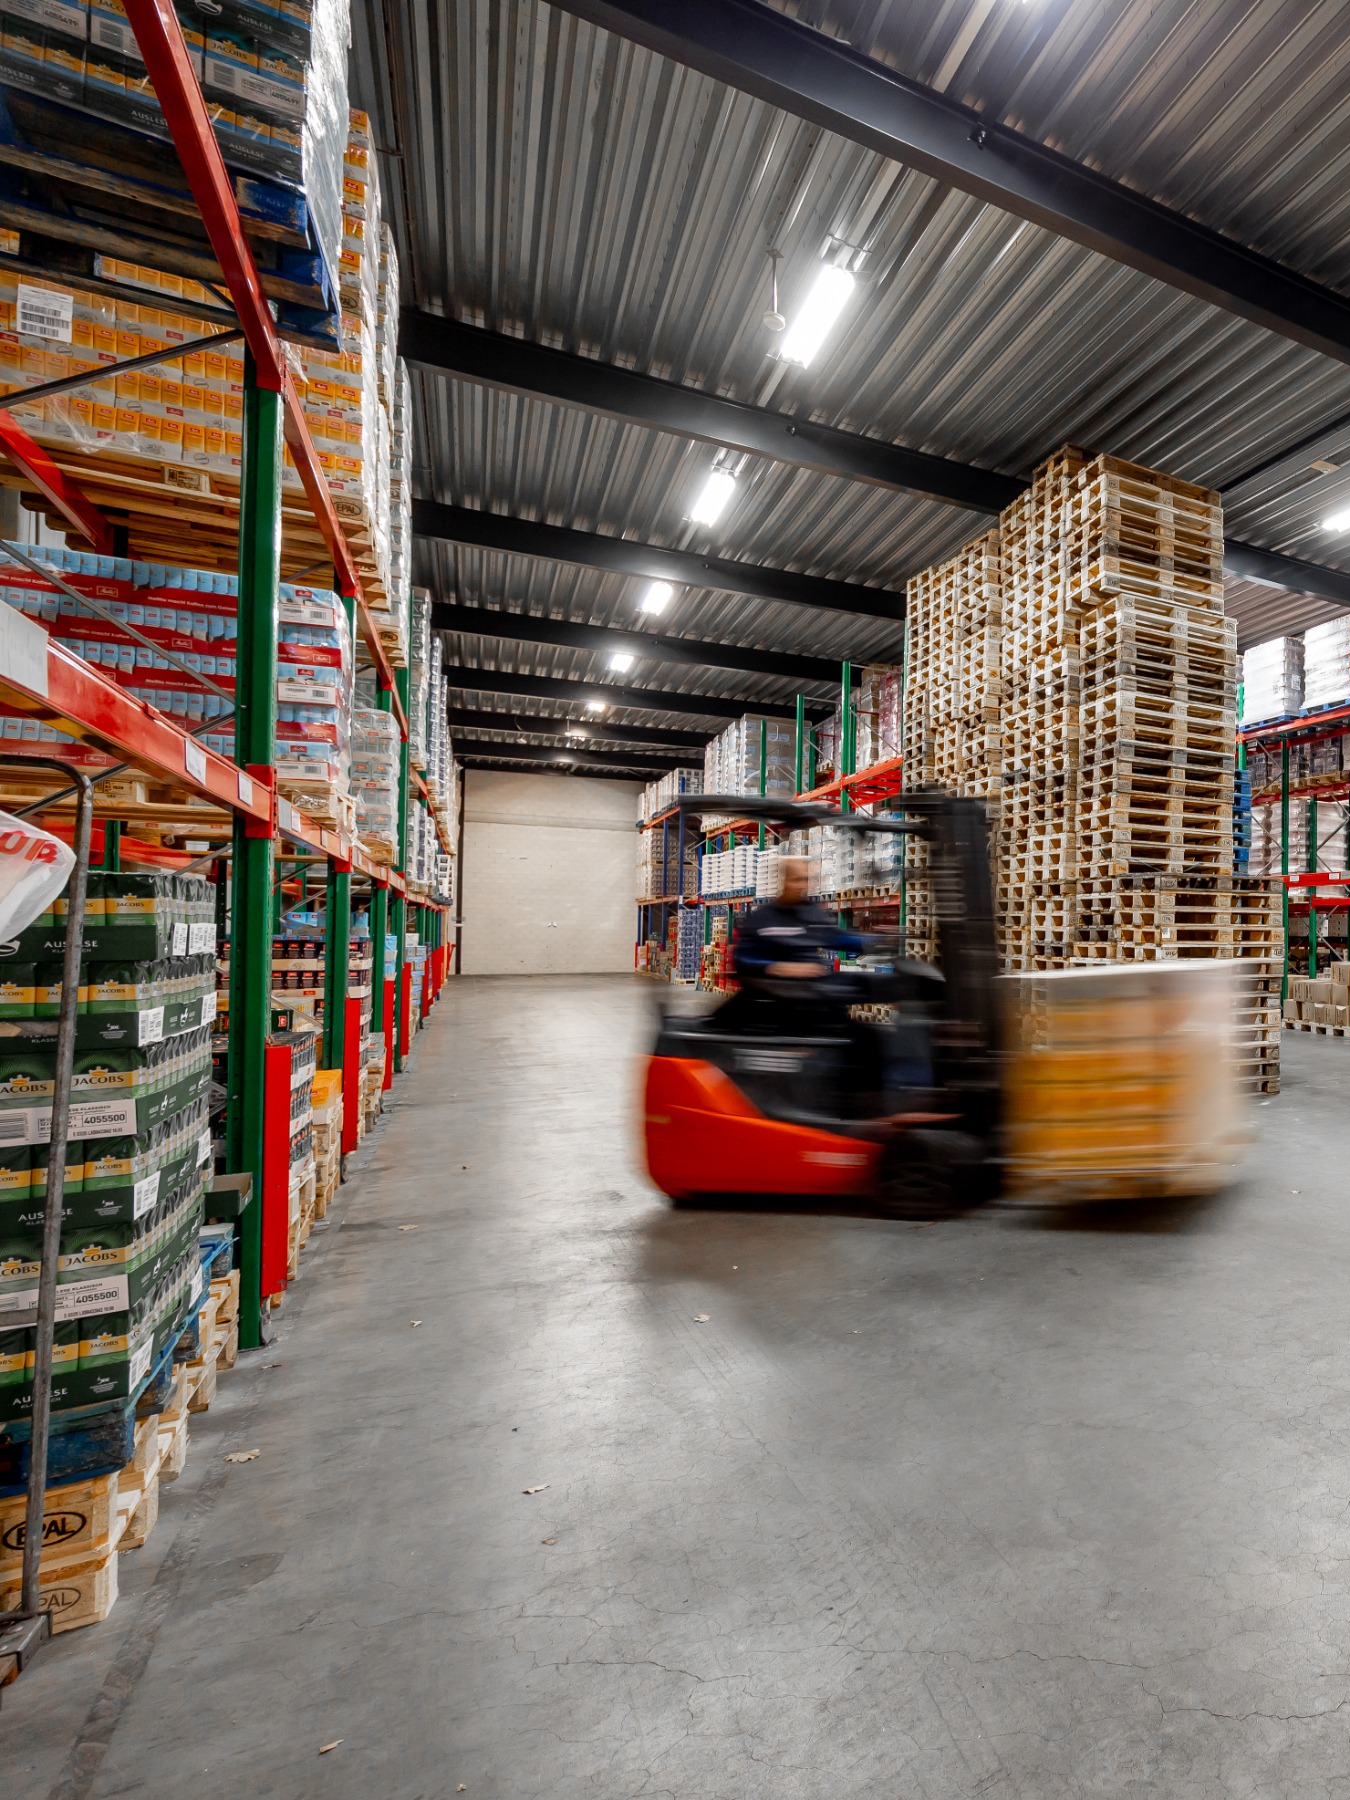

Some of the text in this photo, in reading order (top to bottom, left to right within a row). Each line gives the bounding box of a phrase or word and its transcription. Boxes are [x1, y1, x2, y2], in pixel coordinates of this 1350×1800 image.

[212, 43, 248, 60] JACOBS
[0, 66, 36, 82] USLESE
[265, 61, 298, 78] JACOBS
[131, 110, 168, 126] AUSLES
[74, 1075, 125, 1087] JACOBS
[0, 1084, 47, 1094] ACOBS
[84, 1114, 125, 1125] 4055500
[18, 1208, 73, 1221] AUSSE
[65, 1252, 118, 1266] JACOBS
[0, 1264, 39, 1277] COBS
[76, 1290, 118, 1305] 4055500
[90, 1340, 119, 1349] JACOBS
[16, 1517, 75, 1546] EAL
